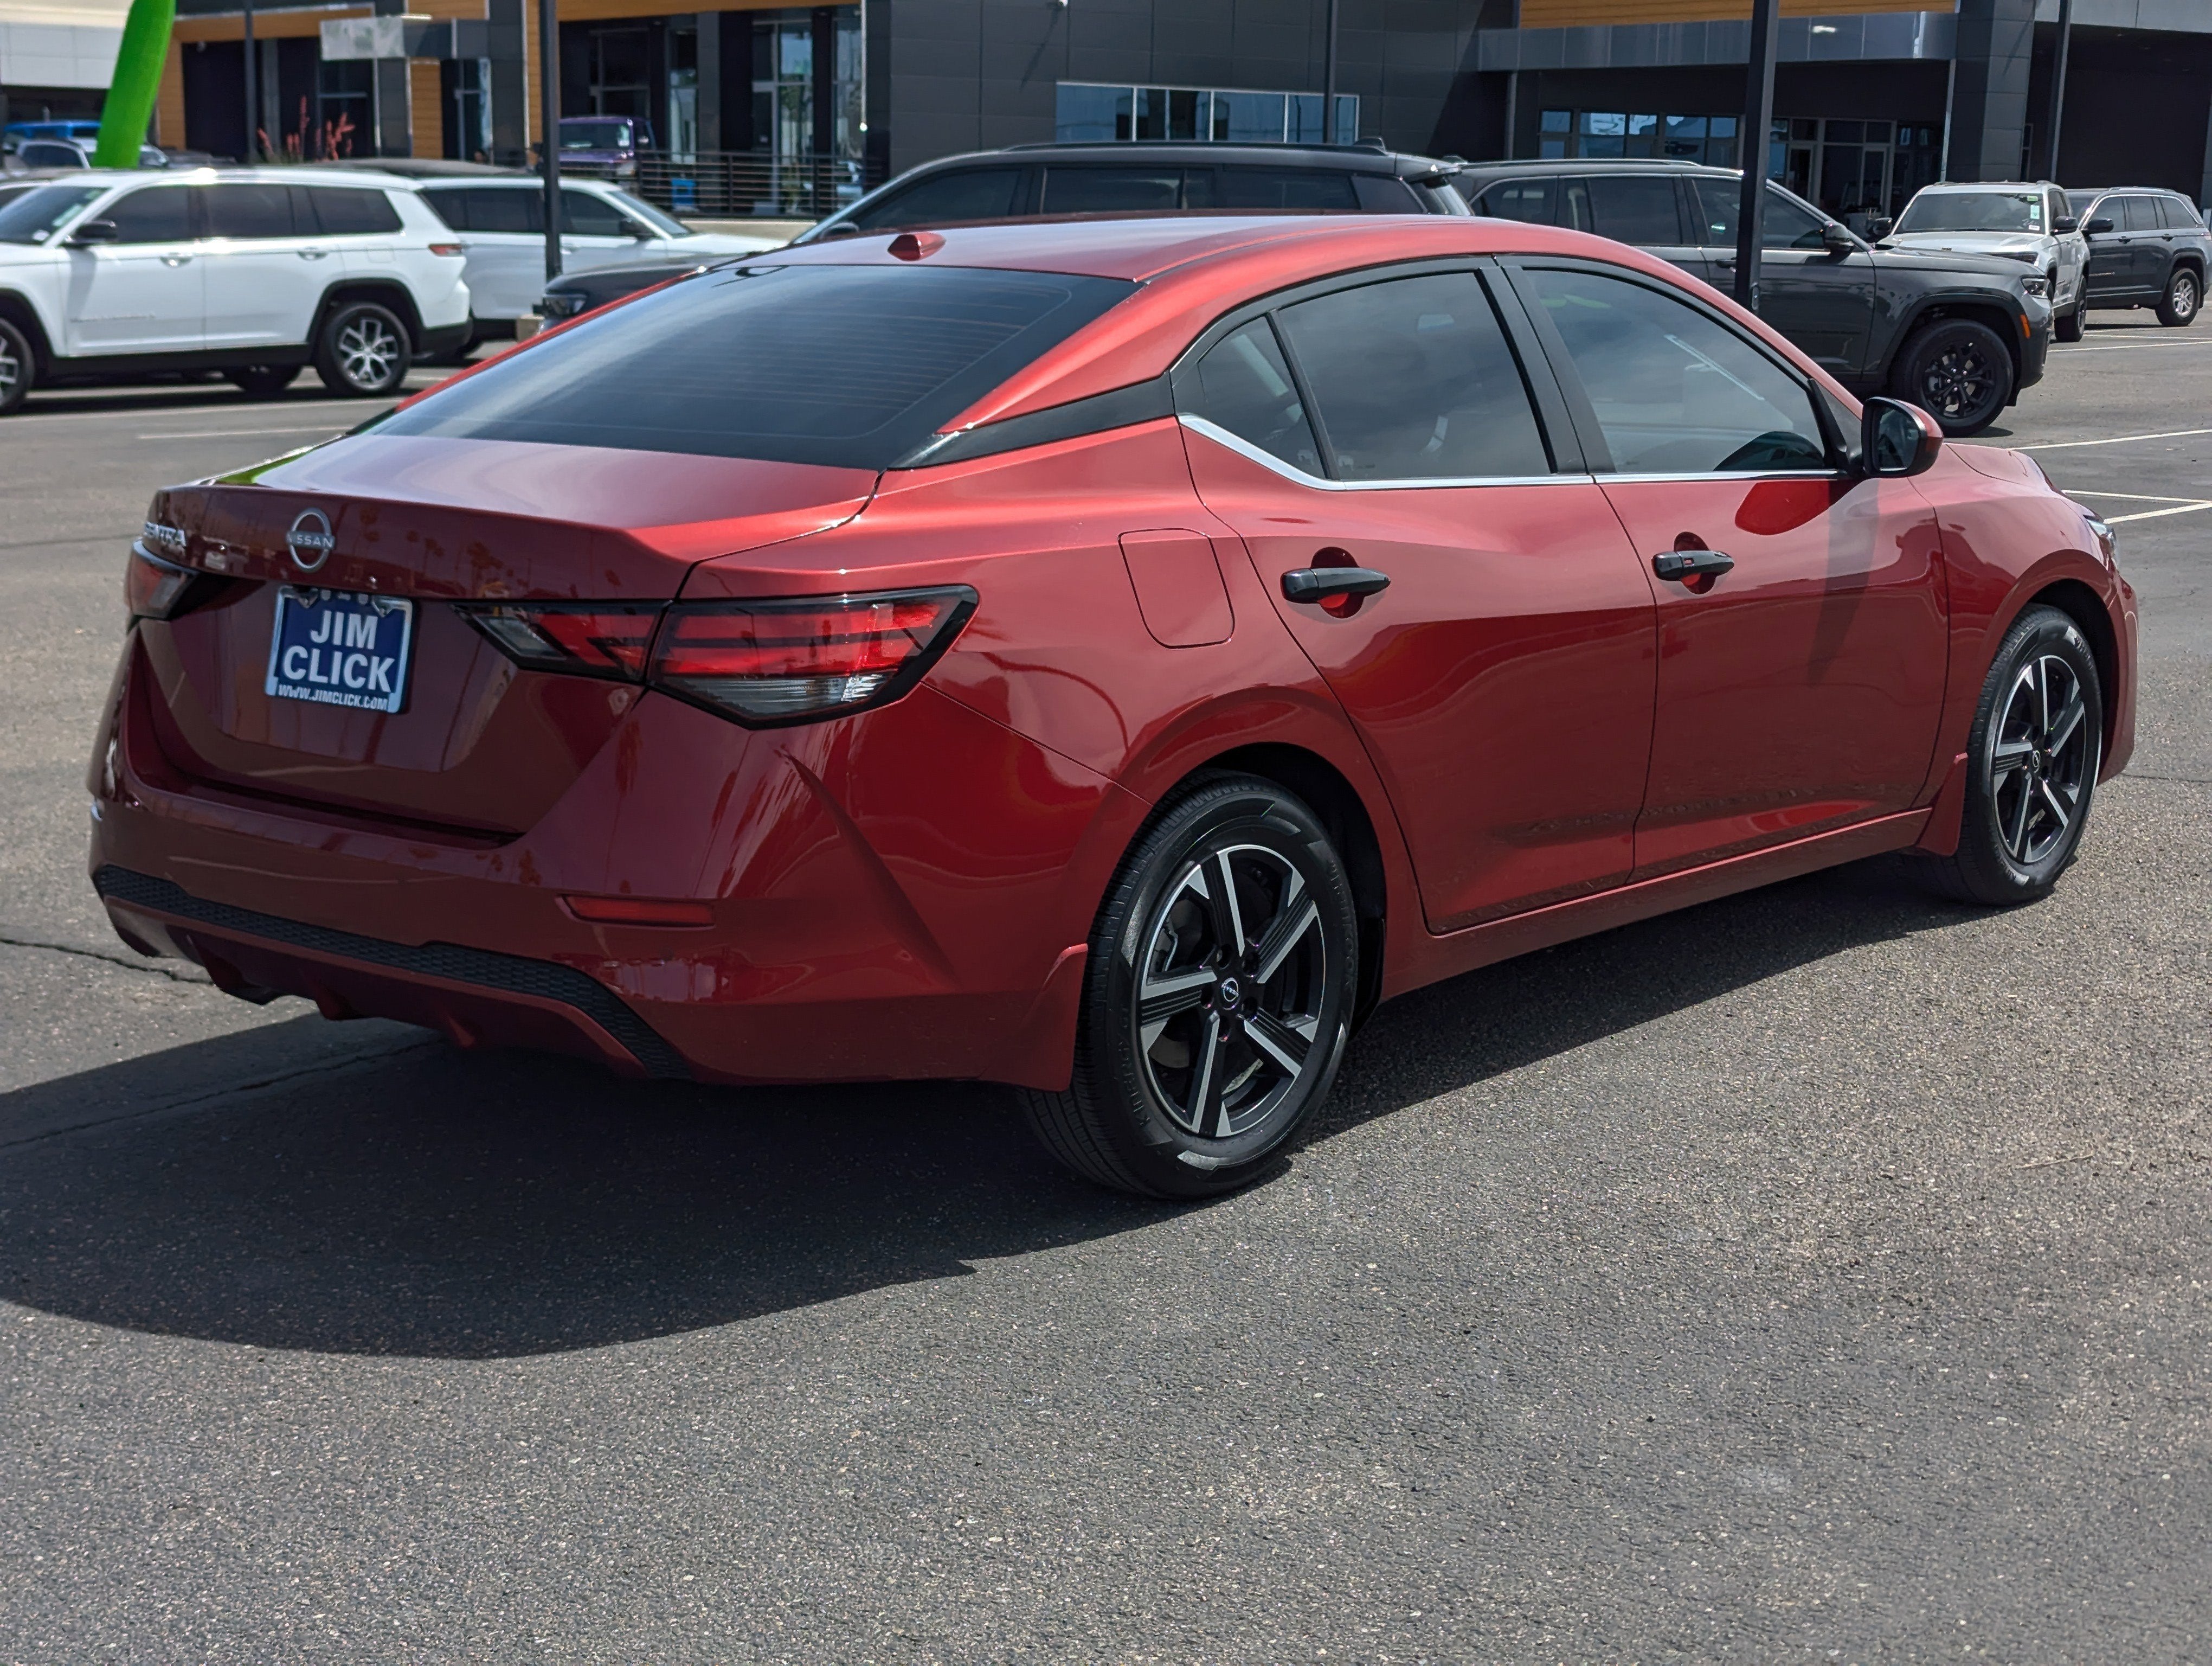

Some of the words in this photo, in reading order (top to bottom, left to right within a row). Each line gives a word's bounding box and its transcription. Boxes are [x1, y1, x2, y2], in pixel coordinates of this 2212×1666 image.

[287, 534, 334, 548] NSSAN
[310, 611, 378, 650] JIM
[284, 645, 395, 693] CLICK
[278, 684, 388, 710] WWW.JIMCLICK.COM
